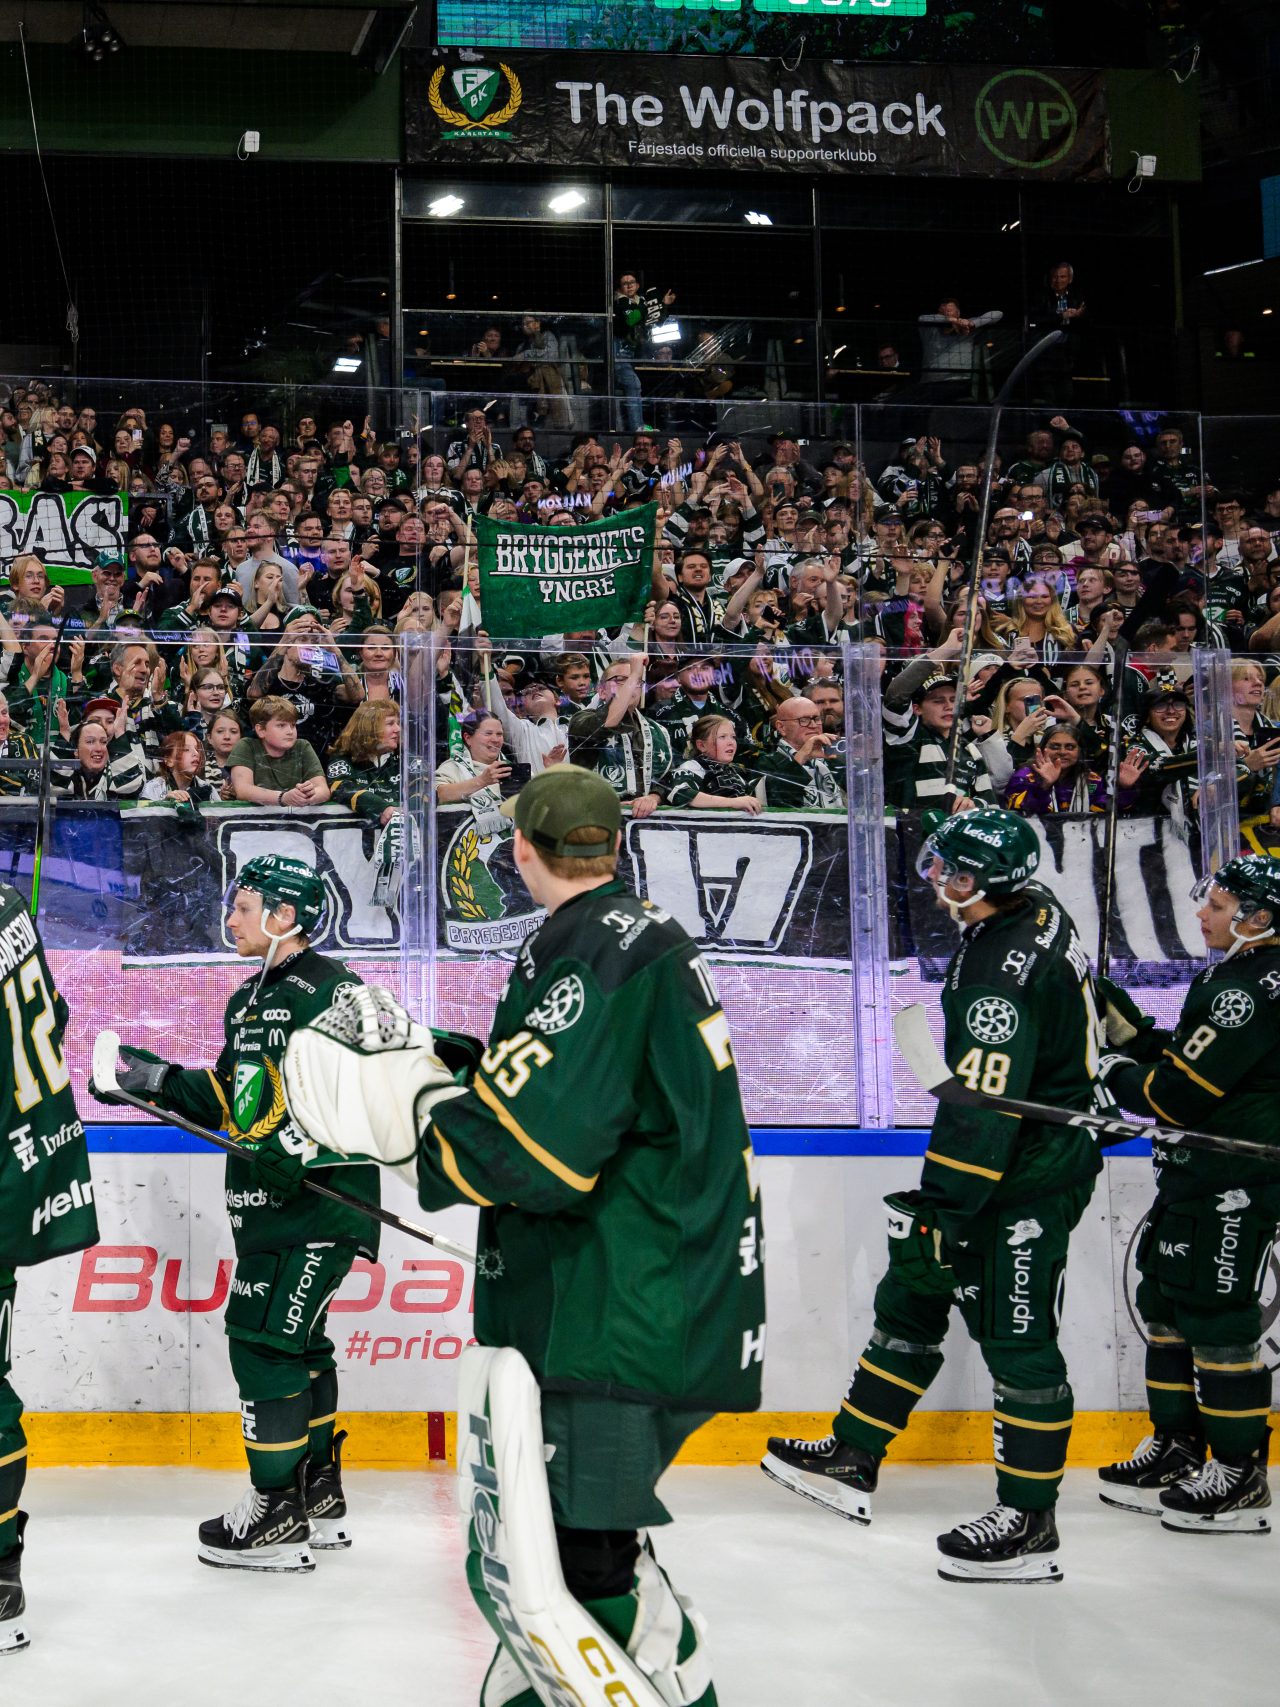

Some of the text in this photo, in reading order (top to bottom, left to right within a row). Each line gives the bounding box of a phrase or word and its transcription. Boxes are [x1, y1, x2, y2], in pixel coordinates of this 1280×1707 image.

[555, 81, 947, 144] The Wolfpack
[983, 99, 1071, 140] WP
[628, 140, 877, 164] Färjestads officiella supporterklubb
[496, 525, 646, 574] BRYGGERIETS
[538, 574, 617, 604] YNGRE
[963, 823, 1003, 848] Lecab
[279, 861, 314, 878] Lecab
[958, 854, 984, 869] CCM
[3, 953, 71, 1114] 12
[1182, 1024, 1219, 1061] 8
[955, 1046, 1012, 1097] 48
[1066, 1114, 1188, 1145] CCM
[1213, 1214, 1243, 1296] upfront
[282, 1252, 324, 1336] upfront
[1008, 1247, 1036, 1336] upfront
[825, 1464, 858, 1476] CCM
[251, 1515, 295, 1550] CCM
